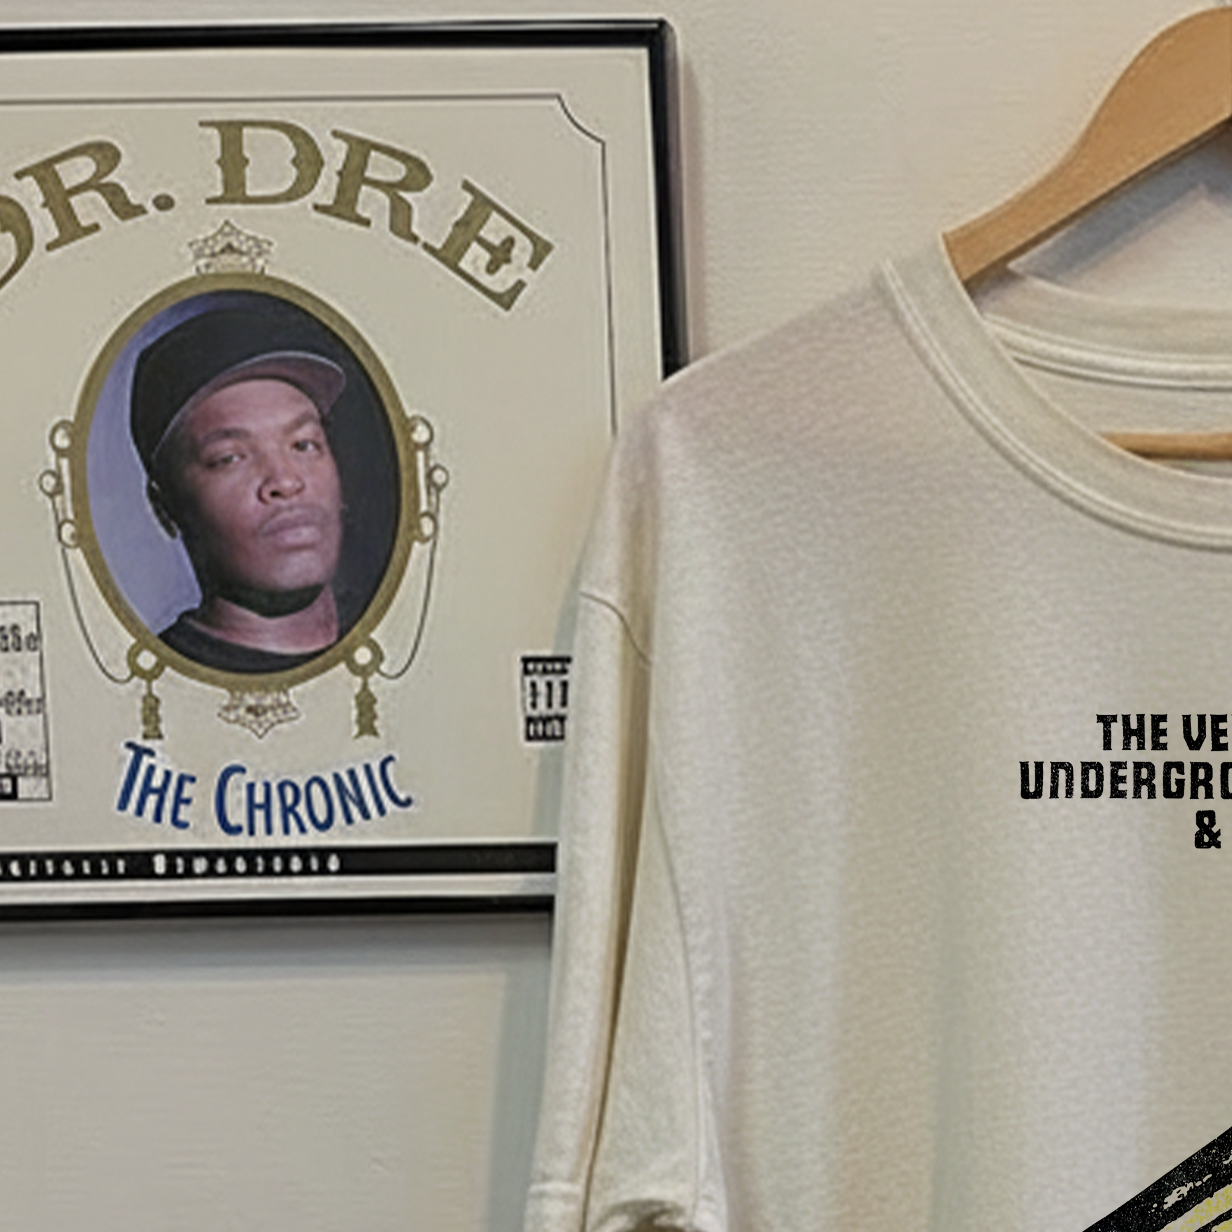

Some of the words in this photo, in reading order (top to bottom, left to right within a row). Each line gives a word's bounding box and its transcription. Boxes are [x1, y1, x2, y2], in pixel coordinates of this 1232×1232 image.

[198, 118, 555, 312] DRE
[1095, 713, 1169, 751] THE
[1194, 809, 1222, 850] &
